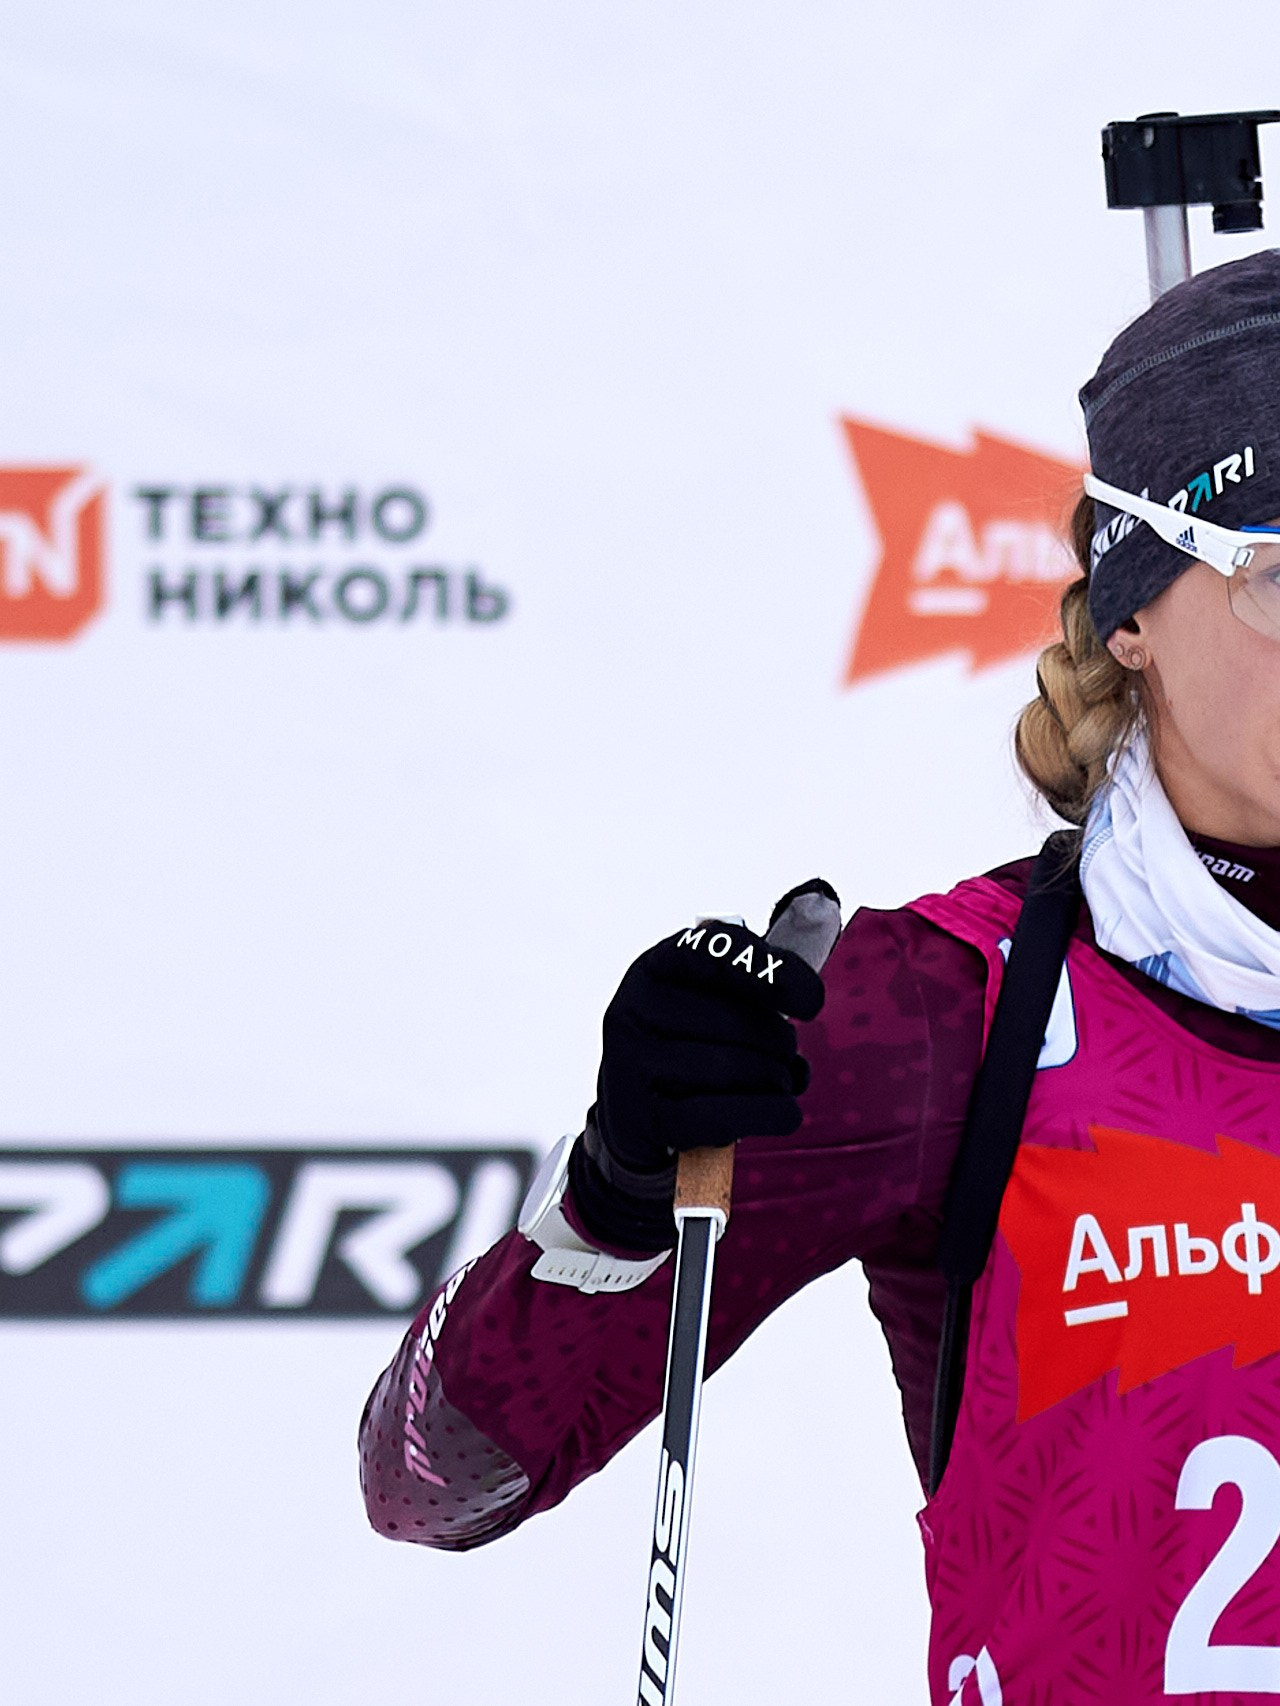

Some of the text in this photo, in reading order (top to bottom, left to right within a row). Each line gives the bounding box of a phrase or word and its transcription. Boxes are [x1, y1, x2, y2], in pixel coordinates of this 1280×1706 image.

[137, 486, 427, 544] ТЕХНО
[149, 565, 511, 623] НИКОЛЬ
[676, 927, 784, 985] MOAX
